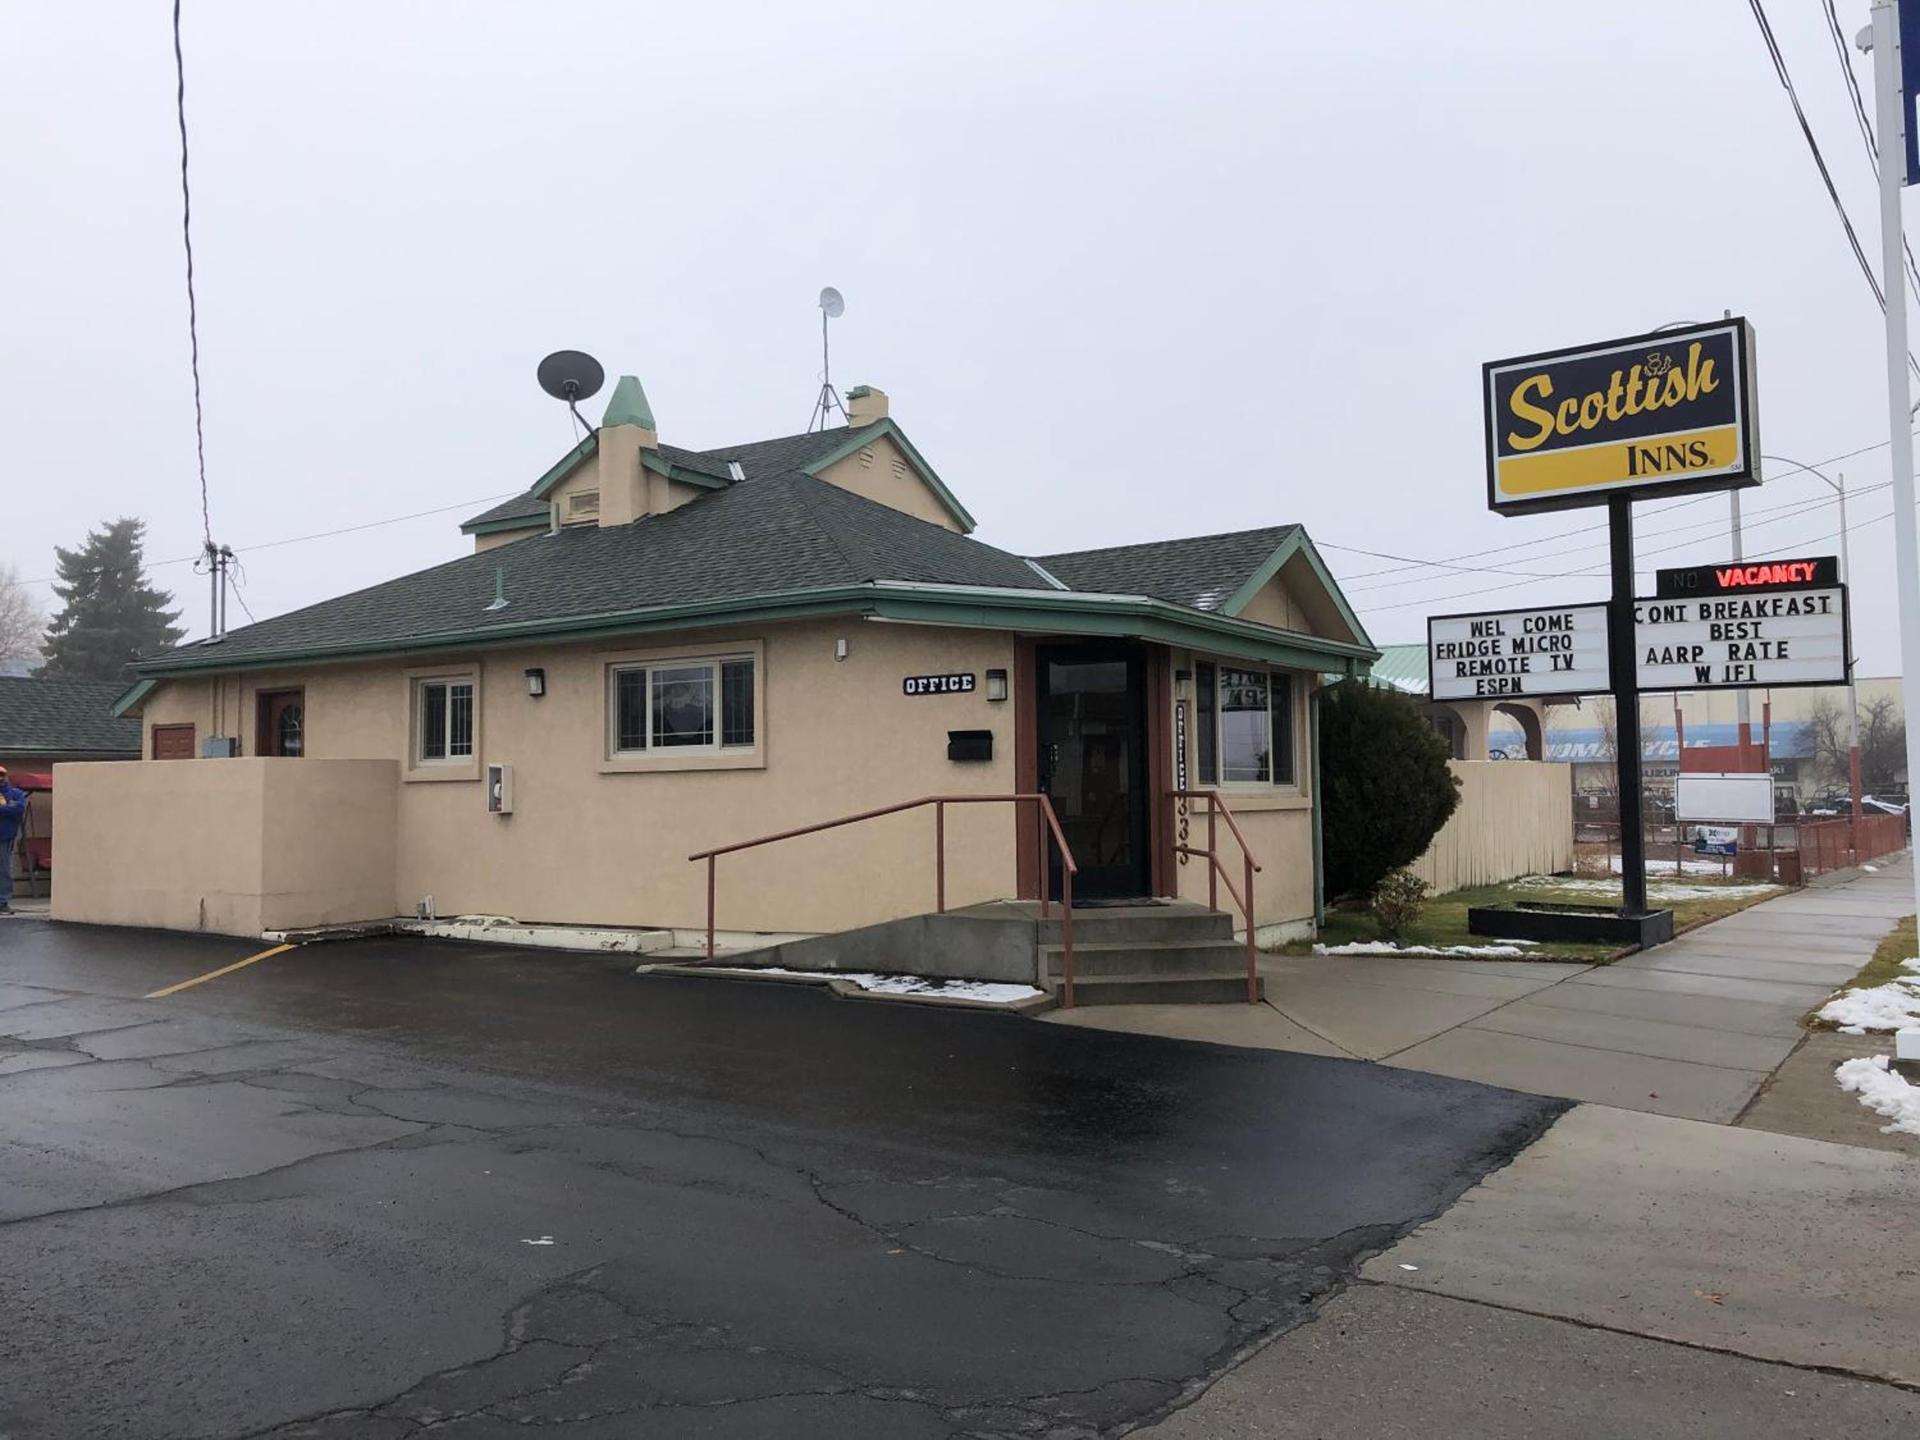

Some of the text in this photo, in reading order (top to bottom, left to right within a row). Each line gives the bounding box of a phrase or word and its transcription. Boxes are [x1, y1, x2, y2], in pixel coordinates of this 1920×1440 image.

[1508, 342, 1719, 450] Scottish
[1628, 440, 1709, 476] INNS
[1673, 562, 1817, 589] NO VACANCY
[1699, 595, 1831, 621] BREAKFAST
[1710, 621, 1762, 642] BEST
[1436, 639, 1502, 660] FRIDGE
[1645, 640, 1789, 665] AARP RATE
[1456, 653, 1575, 678] REMOTE TV
[906, 675, 972, 693] OFFICE
[1475, 676, 1523, 696] ESPN
[1177, 706, 1187, 791] OFFICE
